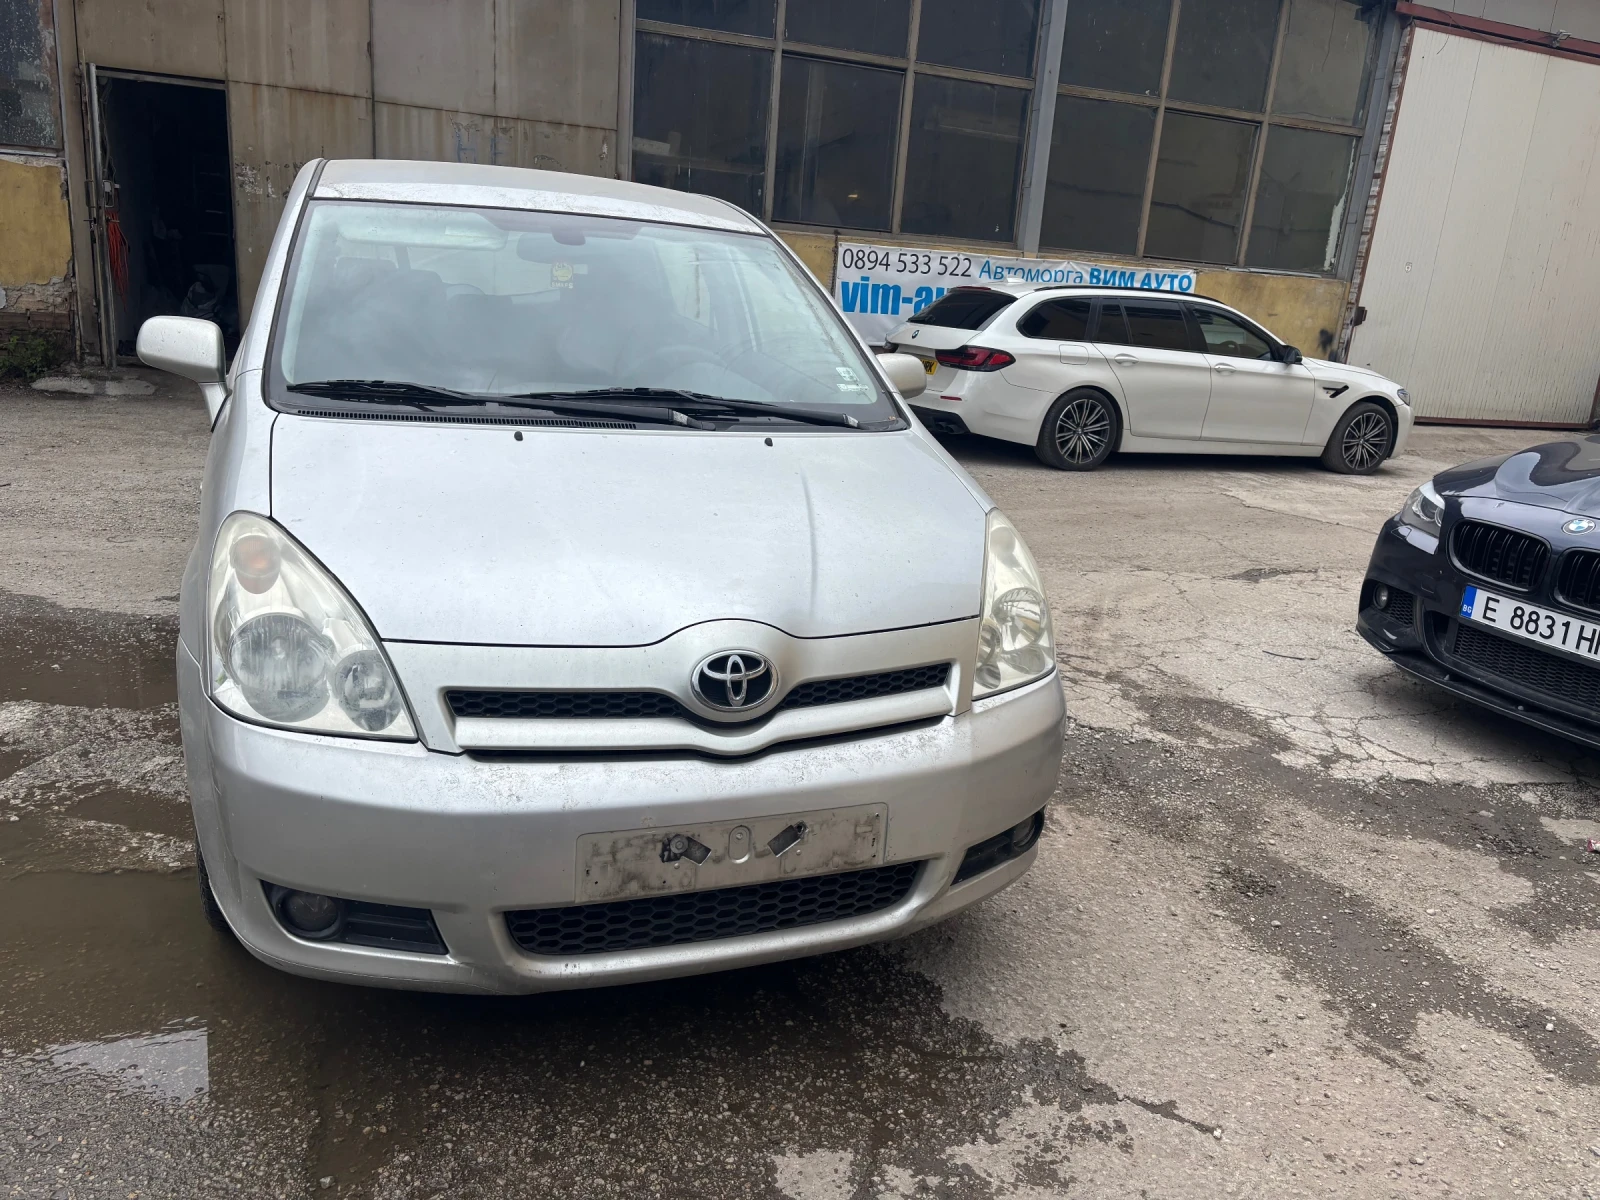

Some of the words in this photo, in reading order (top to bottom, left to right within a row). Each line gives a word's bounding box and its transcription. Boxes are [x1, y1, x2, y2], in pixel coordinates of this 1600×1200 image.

[842, 248, 891, 272] 0894
[896, 252, 932, 275] 533
[937, 255, 972, 278] 522
[1089, 267, 1136, 289] ВИМ
[1462, 604, 1473, 614] BG
[1482, 595, 1500, 623] E
[1509, 606, 1571, 645] 8831
[1575, 624, 1600, 655] H
